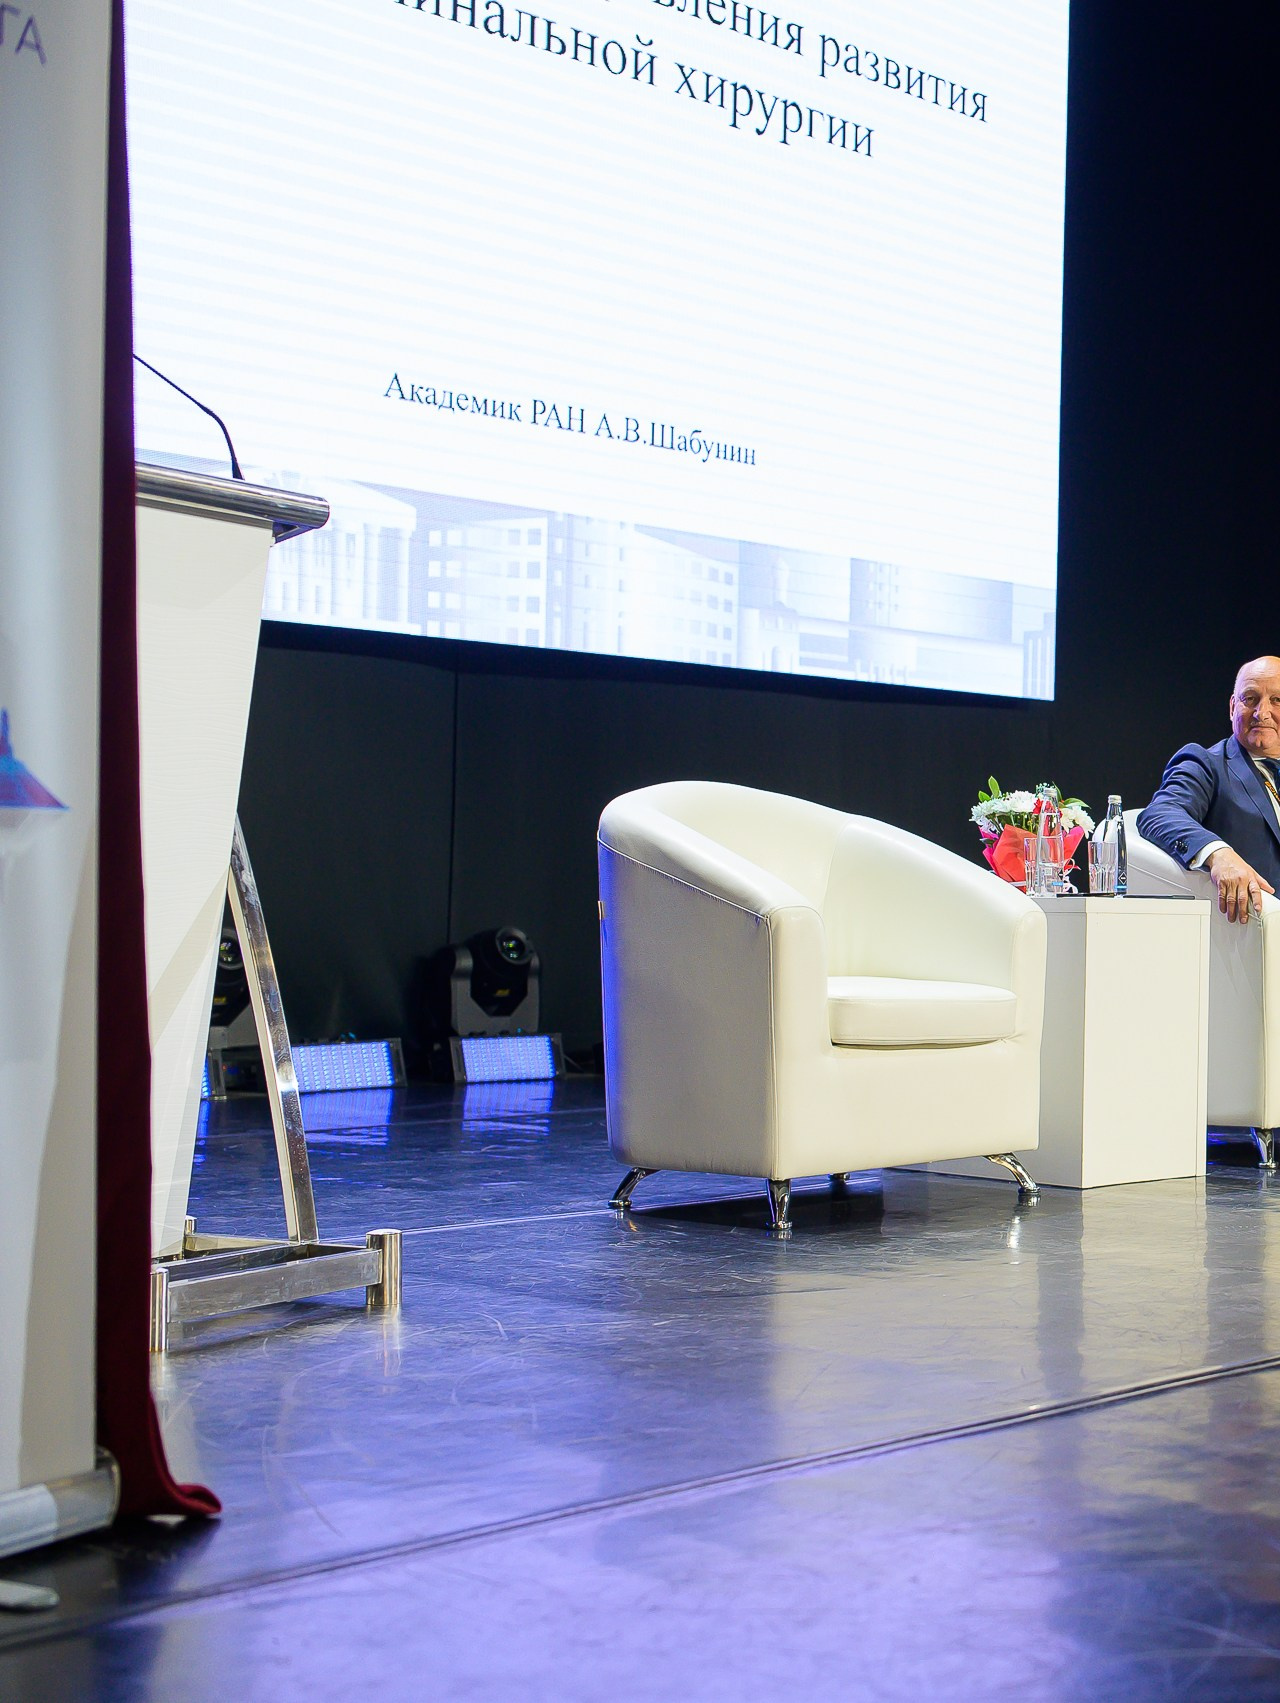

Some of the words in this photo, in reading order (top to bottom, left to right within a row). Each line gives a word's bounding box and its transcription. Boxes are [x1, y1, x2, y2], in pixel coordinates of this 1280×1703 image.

[674, 62, 875, 157] хирургии
[819, 34, 989, 123] развития
[383, 373, 523, 422] Академик
[530, 399, 587, 434] РАН
[594, 413, 757, 466] А.В.Шабунин
